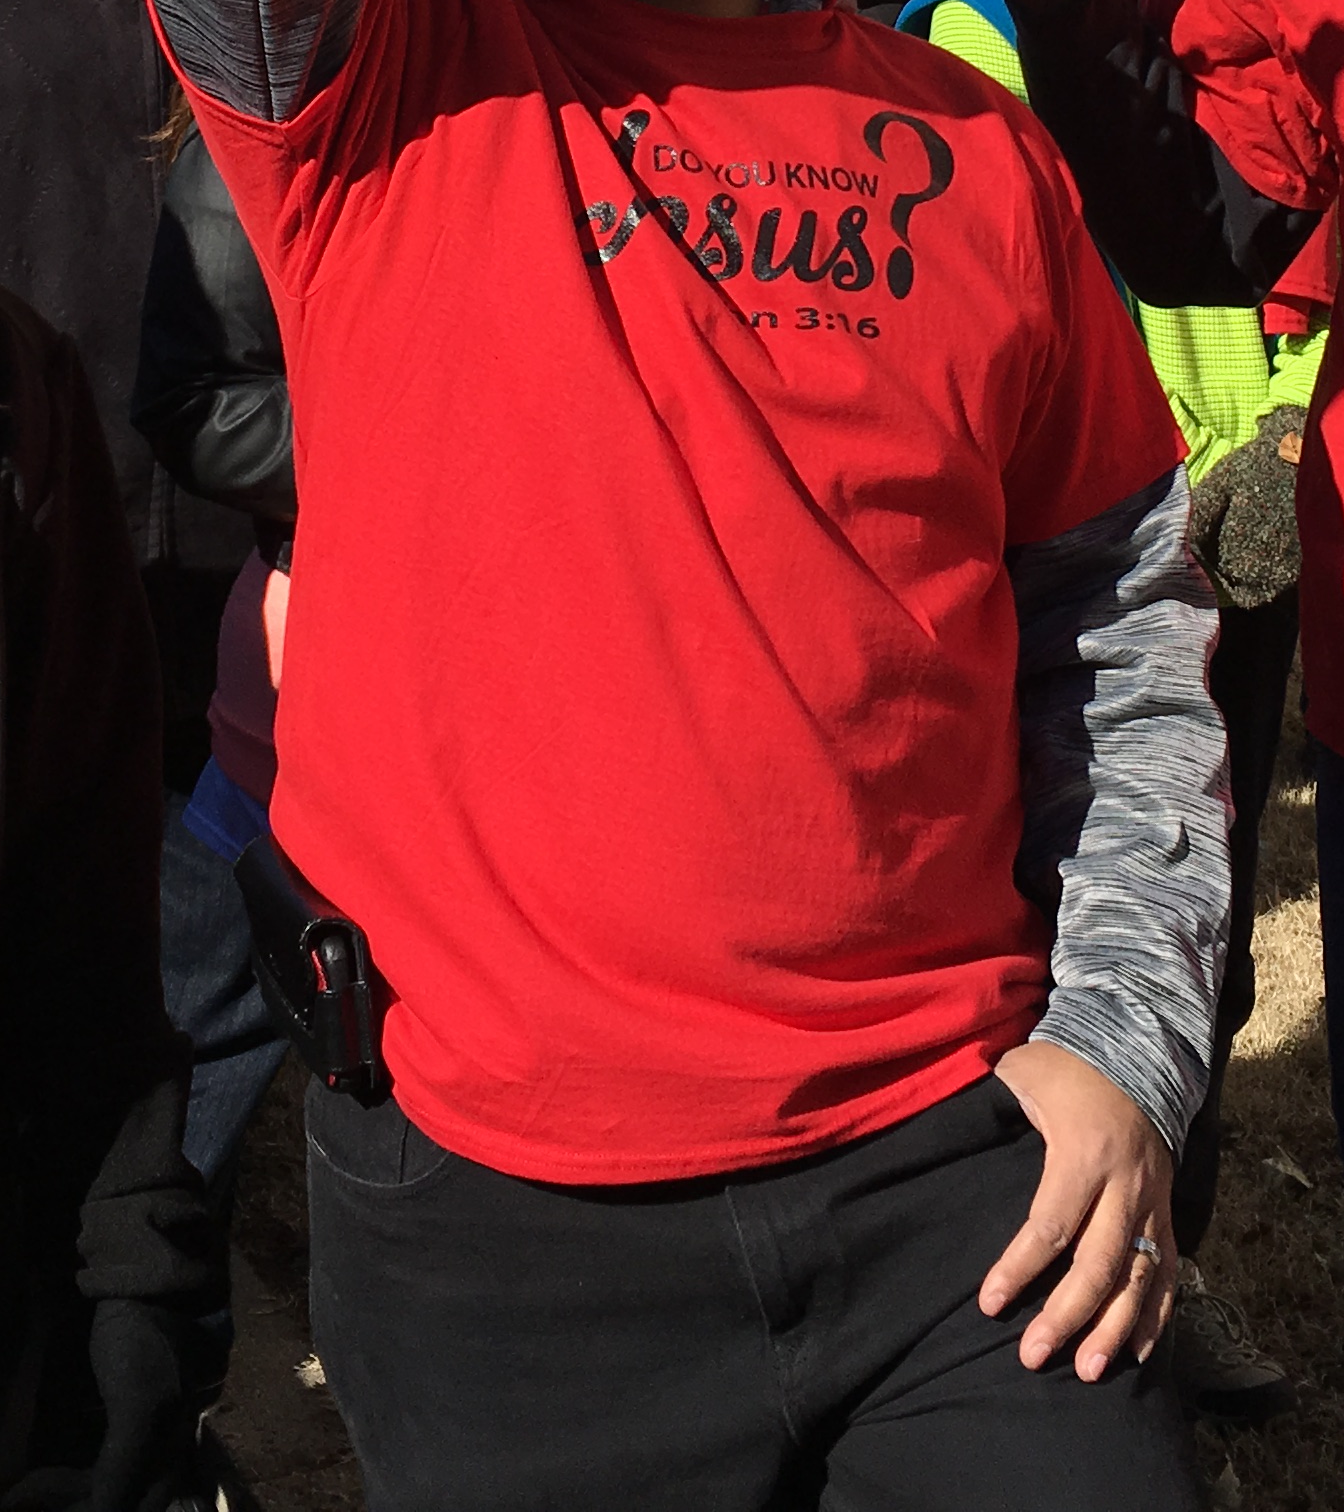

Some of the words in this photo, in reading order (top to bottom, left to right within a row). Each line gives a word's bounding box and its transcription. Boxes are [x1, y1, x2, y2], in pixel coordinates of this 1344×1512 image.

[653, 144, 703, 174] DO
[785, 161, 879, 198] KNOW
[794, 306, 881, 340] 3:16
